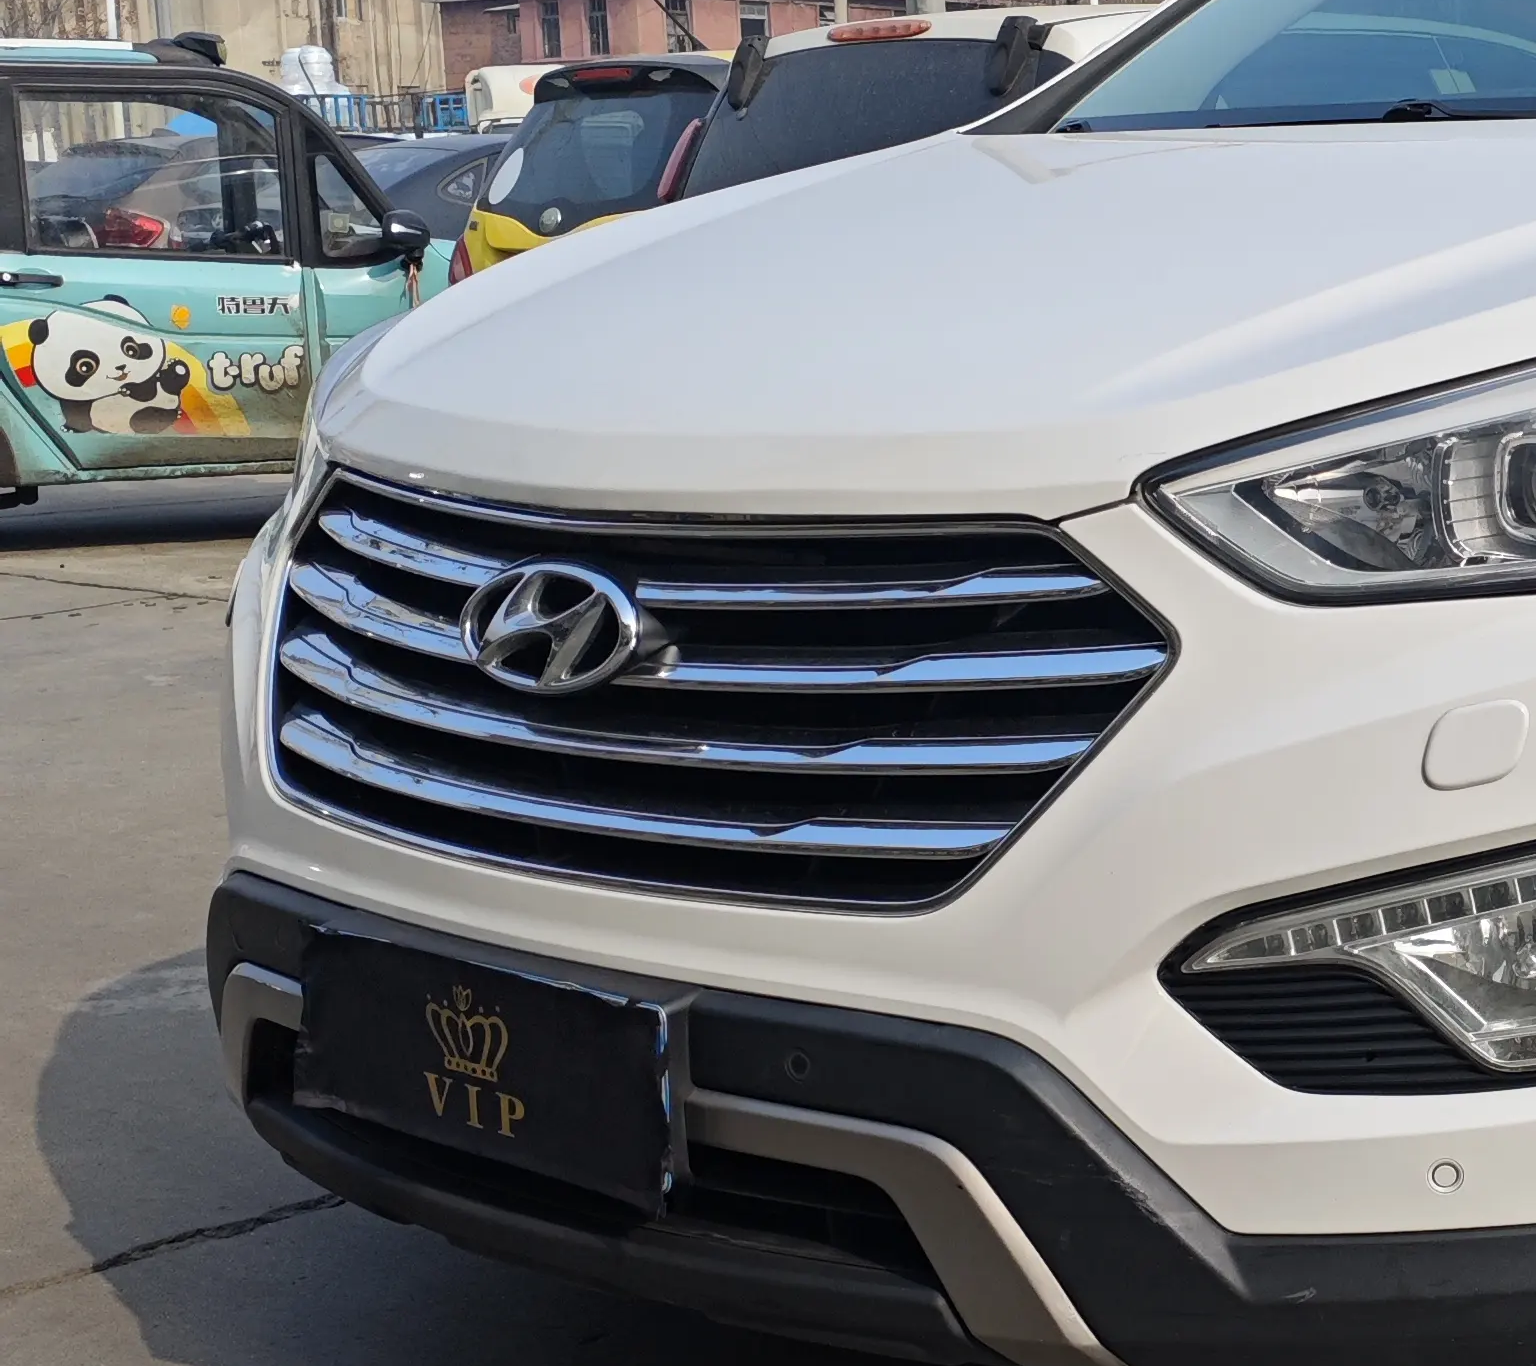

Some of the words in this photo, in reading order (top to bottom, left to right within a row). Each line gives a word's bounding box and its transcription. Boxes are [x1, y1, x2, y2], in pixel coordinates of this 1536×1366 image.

[217, 296, 291, 315] 特鲁夫
[423, 1071, 525, 1138] VIP
